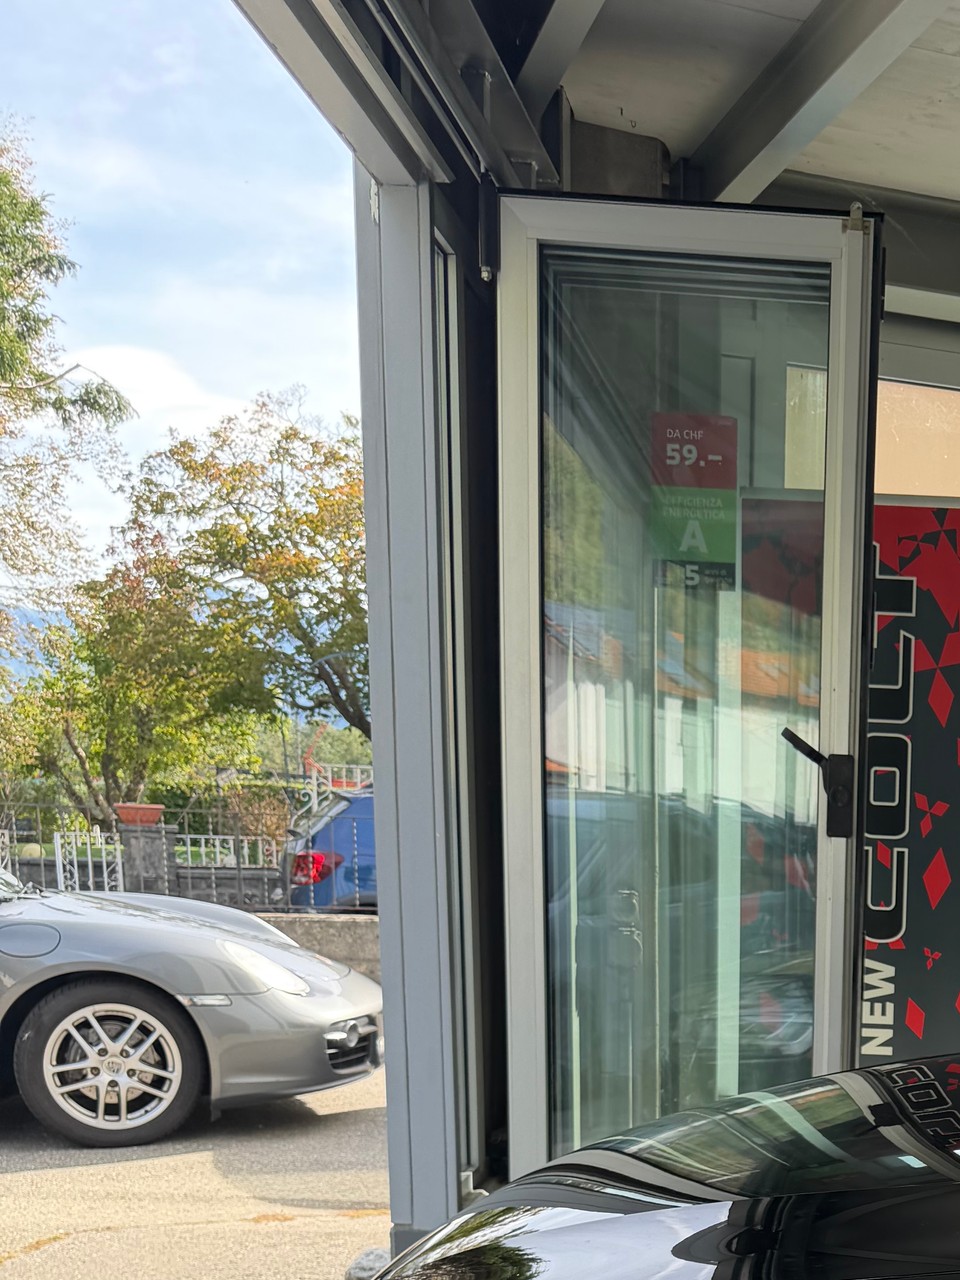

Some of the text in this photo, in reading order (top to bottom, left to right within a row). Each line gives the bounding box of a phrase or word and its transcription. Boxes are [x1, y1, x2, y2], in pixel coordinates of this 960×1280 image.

[666, 428, 705, 440] DA CHF
[679, 519, 709, 553] A
[685, 565, 700, 586] 5
[860, 541, 917, 1056] NEW COLT
